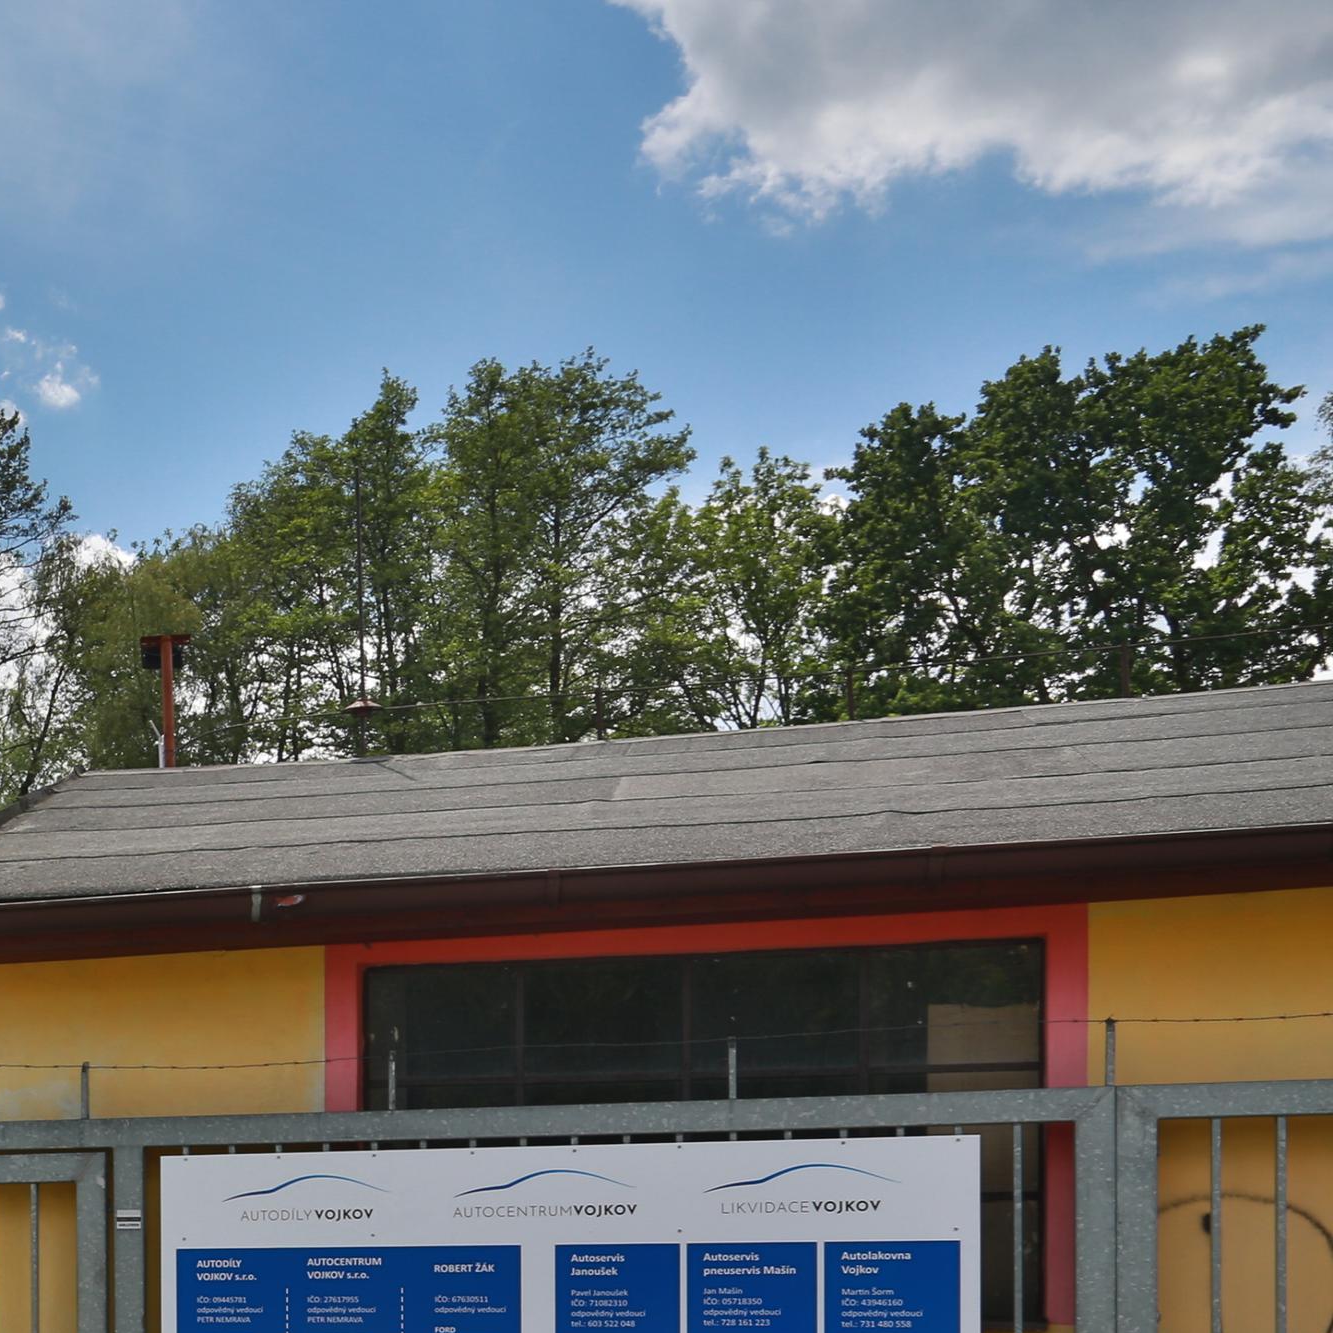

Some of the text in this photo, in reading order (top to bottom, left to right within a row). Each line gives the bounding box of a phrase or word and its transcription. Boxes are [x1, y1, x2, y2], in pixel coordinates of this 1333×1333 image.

[812, 1200, 881, 1214] VOJKOV
[315, 1208, 374, 1222] VOJKOV
[571, 1253, 625, 1262] Autoservis
[703, 1252, 759, 1262] Autoservis
[841, 1251, 912, 1260] Autolakovna
[197, 1258, 242, 1268] AUTODÍLY
[307, 1258, 382, 1266] AUTOCENTRUM
[434, 1262, 495, 1273] ROBERT ŽÁK
[571, 1267, 618, 1276] Janoušek
[703, 1265, 797, 1276] pneuservis Mašín
[841, 1265, 879, 1276] Vojkov
[197, 1273, 233, 1281] VOJKOV
[307, 1271, 345, 1280] VOJKOV
[593, 1289, 629, 1297] Janoušek
[871, 1287, 894, 1295] Šorm
[435, 1306, 506, 1314] odpovědný vedoucí
[571, 1310, 614, 1318] odpovědný
[703, 1308, 748, 1316] odpovědný
[841, 1310, 888, 1318] odpovědný
[307, 1316, 325, 1324] PETR
